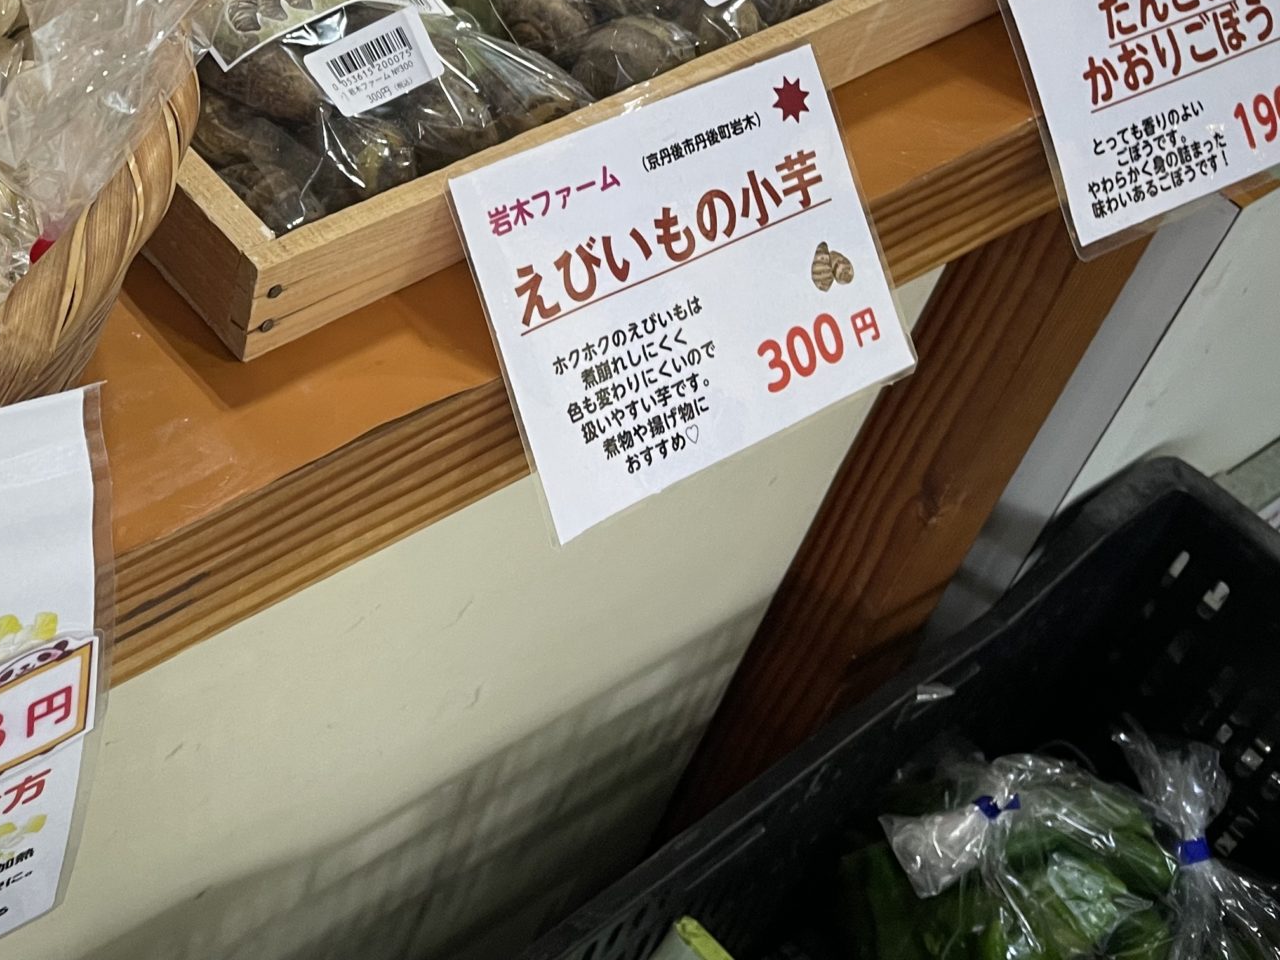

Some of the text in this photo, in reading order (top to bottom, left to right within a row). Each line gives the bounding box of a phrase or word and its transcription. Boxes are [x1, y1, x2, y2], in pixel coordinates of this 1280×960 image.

[376, 49, 412, 72] 200075
[1092, 100, 1205, 156] とっても香りのよい
[1116, 130, 1187, 167] ごぼうです。
[1088, 132, 1228, 200] やわらかく身の詰まった
[487, 165, 621, 238] 岩木ファーム
[514, 150, 823, 328] えびいもの小芋
[553, 295, 703, 376] ホクホクのえびいもは
[580, 327, 688, 391] 煮崩れしにくく
[567, 340, 717, 424] 色も変わりにくいので
[580, 374, 711, 444] 扱いやすい芋です。
[603, 396, 710, 461] 煮物や揚げ物に
